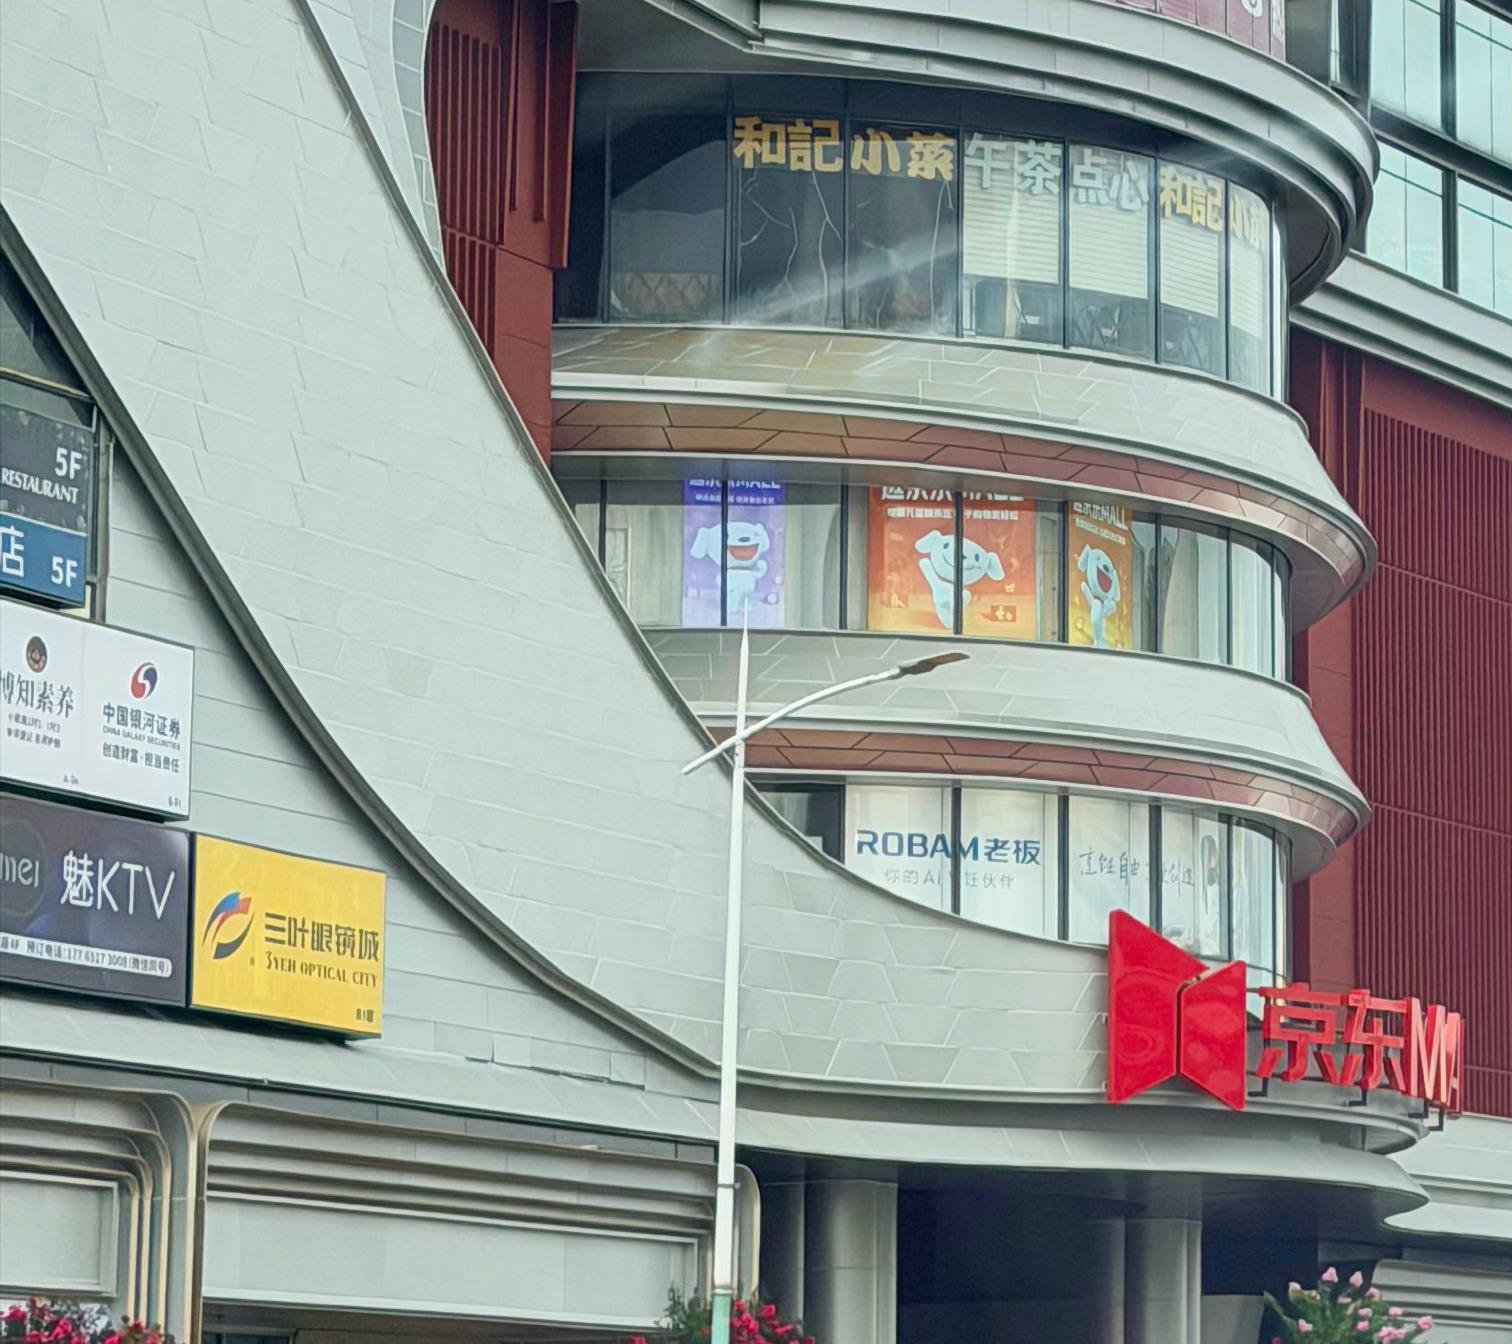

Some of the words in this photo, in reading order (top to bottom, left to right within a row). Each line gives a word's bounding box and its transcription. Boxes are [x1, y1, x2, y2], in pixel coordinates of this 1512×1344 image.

[965, 132, 1149, 211] 午茶点心
[55, 447, 82, 480] 5F
[1, 467, 79, 505] RESTAURANT
[51, 556, 78, 588] 5F
[103, 702, 181, 741] 中国银河证券
[984, 838, 1041, 866] 老板
[265, 912, 380, 962] 三叶眼镜城
[300, 962, 349, 984] OPTICAL
[352, 971, 378, 988] CITY
